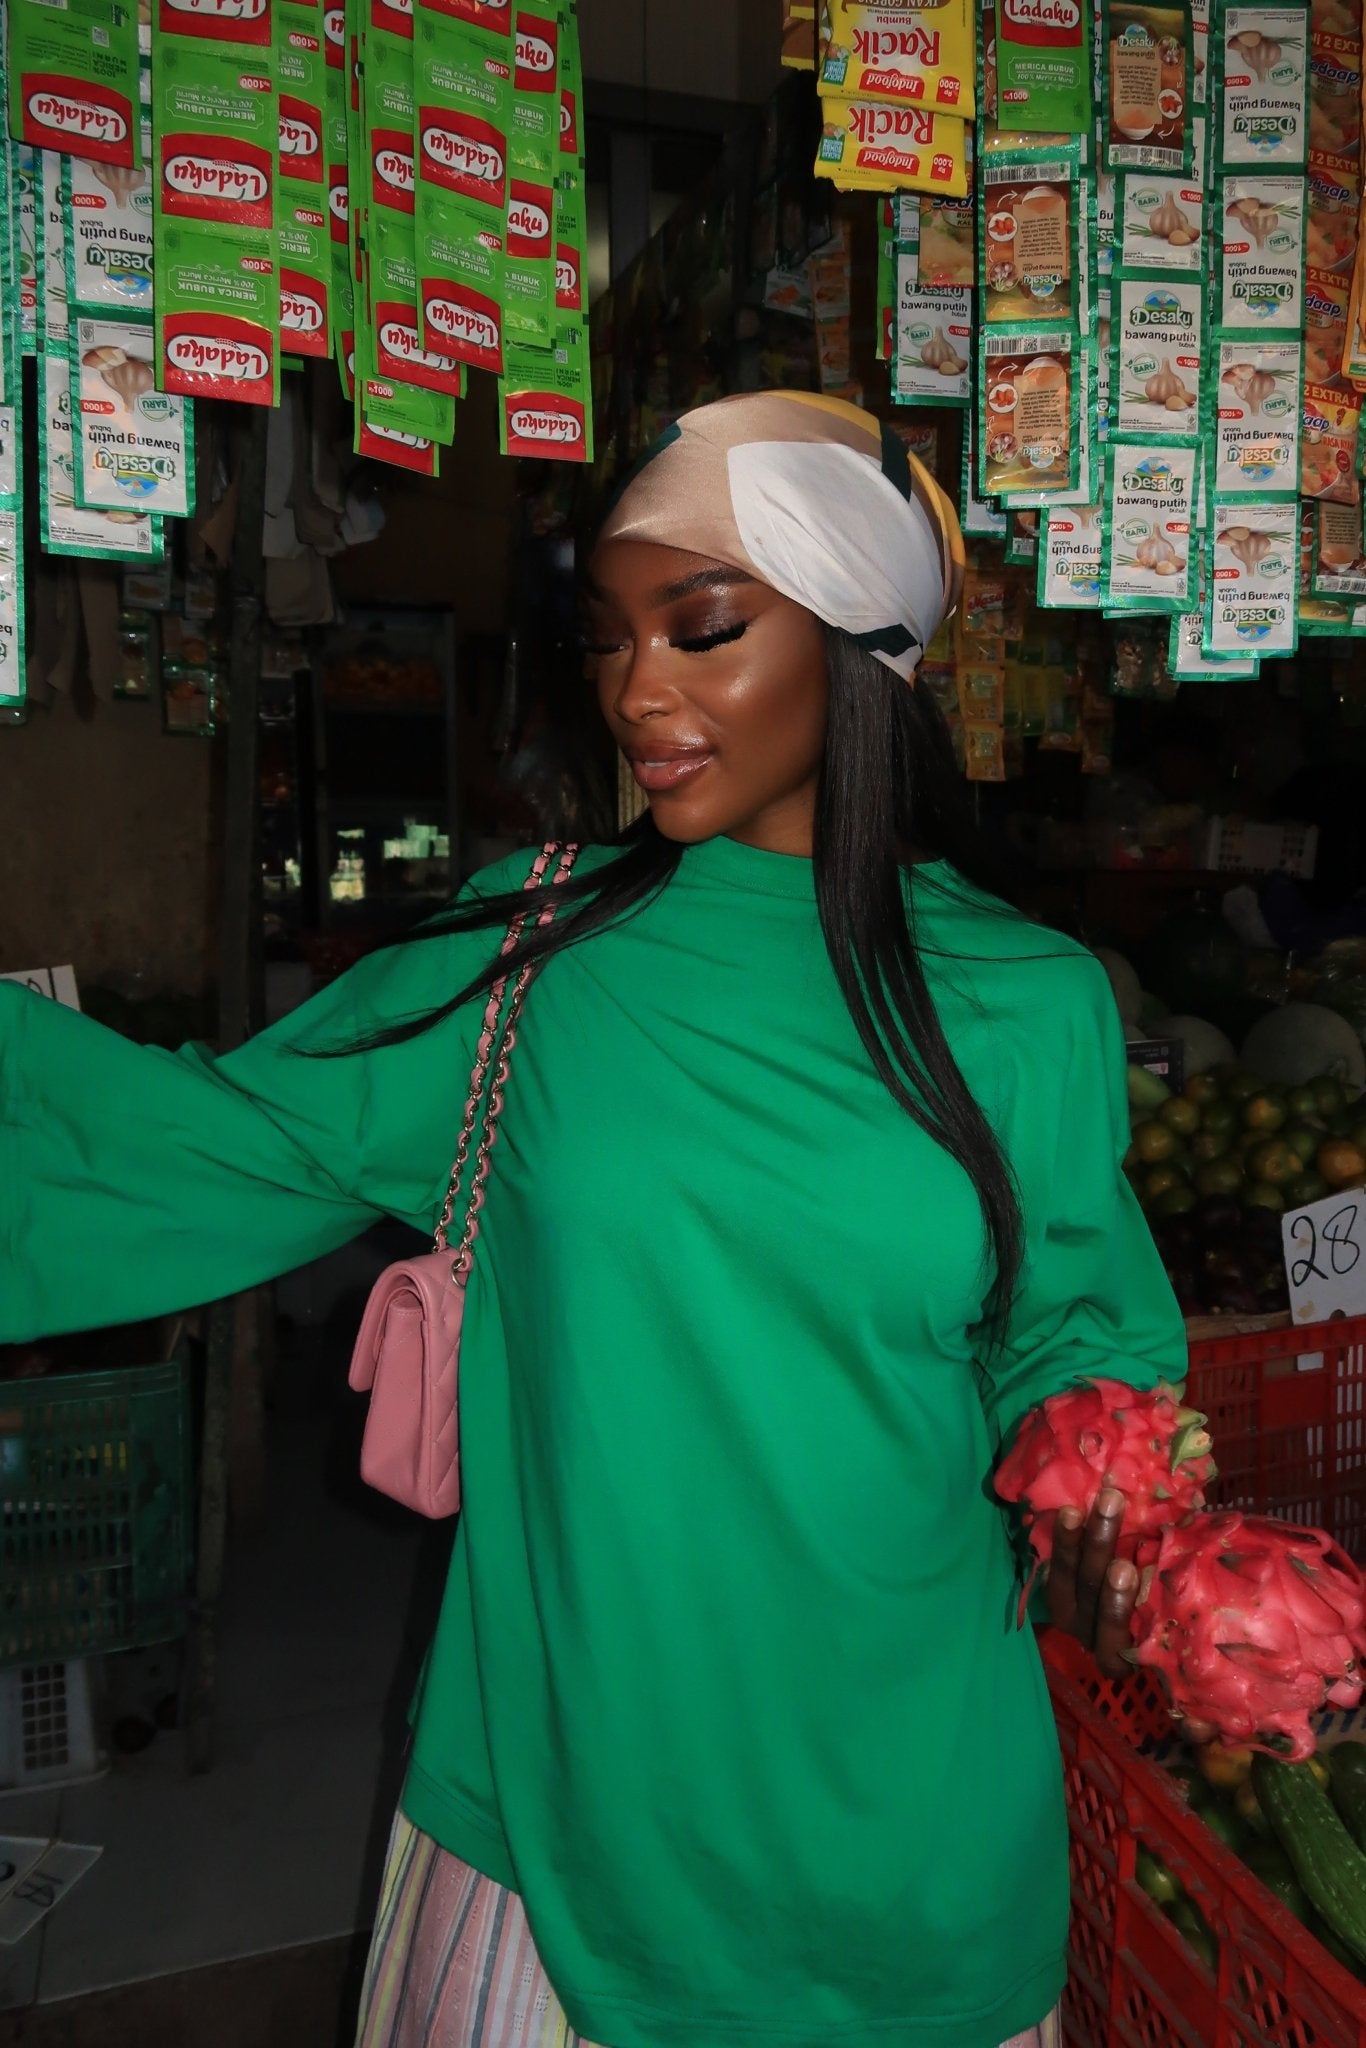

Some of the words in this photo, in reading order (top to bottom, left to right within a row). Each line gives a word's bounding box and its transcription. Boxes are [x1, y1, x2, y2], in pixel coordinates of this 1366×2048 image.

[1010, 0, 1074, 24] Ladaku
[876, 15, 912, 25] Bumbu
[852, 27, 940, 66] Racik
[1117, 35, 1155, 47] Desaku
[1334, 38, 1359, 53] EXT
[515, 41, 548, 67] aku
[281, 68, 305, 78] MERI
[1014, 62, 1046, 72] MERICA
[431, 76, 463, 93] BUBUK
[867, 71, 920, 92] Indofood
[938, 78, 960, 90] 2.000
[465, 86, 497, 105] MERICA
[175, 101, 214, 115] BUBUK
[1229, 99, 1258, 111] putih
[1260, 98, 1300, 112] bawang
[37, 98, 120, 138] Ladaku
[217, 110, 256, 121] MERICA
[514, 106, 545, 121] BUBUK
[848, 107, 934, 145] Racik
[1233, 113, 1297, 136] Desaku
[430, 134, 499, 176] Ladaku
[862, 150, 916, 170] Indofood
[932, 156, 953, 168] 2.000
[1327, 155, 1359, 172] EXTR
[174, 160, 261, 196] Ladaku
[508, 207, 542, 234] aku
[80, 226, 117, 240] putih
[280, 242, 311, 254] MERIC
[431, 249, 459, 265] BUBUK
[461, 258, 490, 276] MERICA
[1228, 265, 1257, 277] putih
[1258, 264, 1297, 278] bawang
[386, 271, 416, 289] BUBUK
[511, 273, 541, 287] BUBUK
[1022, 273, 1063, 285] Desaku
[1310, 269, 1319, 281] 2
[1319, 271, 1351, 288] EXTR
[178, 281, 215, 294] BUBUK
[219, 288, 257, 301] MERICA
[1232, 279, 1294, 303] Desaku
[901, 300, 941, 312] bawang
[943, 304, 968, 313] putih
[1305, 294, 1341, 317] daap
[432, 303, 495, 344] Ladaku
[1129, 305, 1194, 329] Desaku
[910, 330, 930, 340] BARU
[1124, 330, 1168, 342] bawang
[1169, 332, 1197, 342] putih
[176, 339, 262, 375] Ladaku
[1133, 363, 1156, 373] BARU
[1303, 384, 1311, 396] 2
[1311, 388, 1349, 406] EXTRA
[1351, 396, 1359, 408] 1
[83, 402, 106, 411] 1000
[141, 399, 168, 410] BARU
[1264, 400, 1287, 410] BARU
[1219, 410, 1236, 418] 1000
[89, 424, 112, 433] bubuk
[517, 413, 577, 438] Ladaku
[89, 431, 124, 444] putih
[1222, 431, 1251, 442] putih
[1252, 430, 1294, 442] bawang
[127, 433, 180, 454] bawang
[95, 446, 176, 480] Desaku
[1227, 445, 1291, 467] Desaku
[1121, 471, 1184, 495] Desaku
[1116, 496, 1158, 508] bawang
[1159, 498, 1187, 509] putih
[1124, 527, 1148, 537] BARU
[1051, 544, 1081, 556] putih
[1082, 545, 1102, 555] ang
[1056, 559, 1100, 582] esaku
[1260, 560, 1282, 571] BARU
[1218, 591, 1247, 604] putih
[1248, 591, 1290, 603] bawang
[1221, 605, 1286, 626] Desaku
[1290, 1204, 1361, 1288] 28
